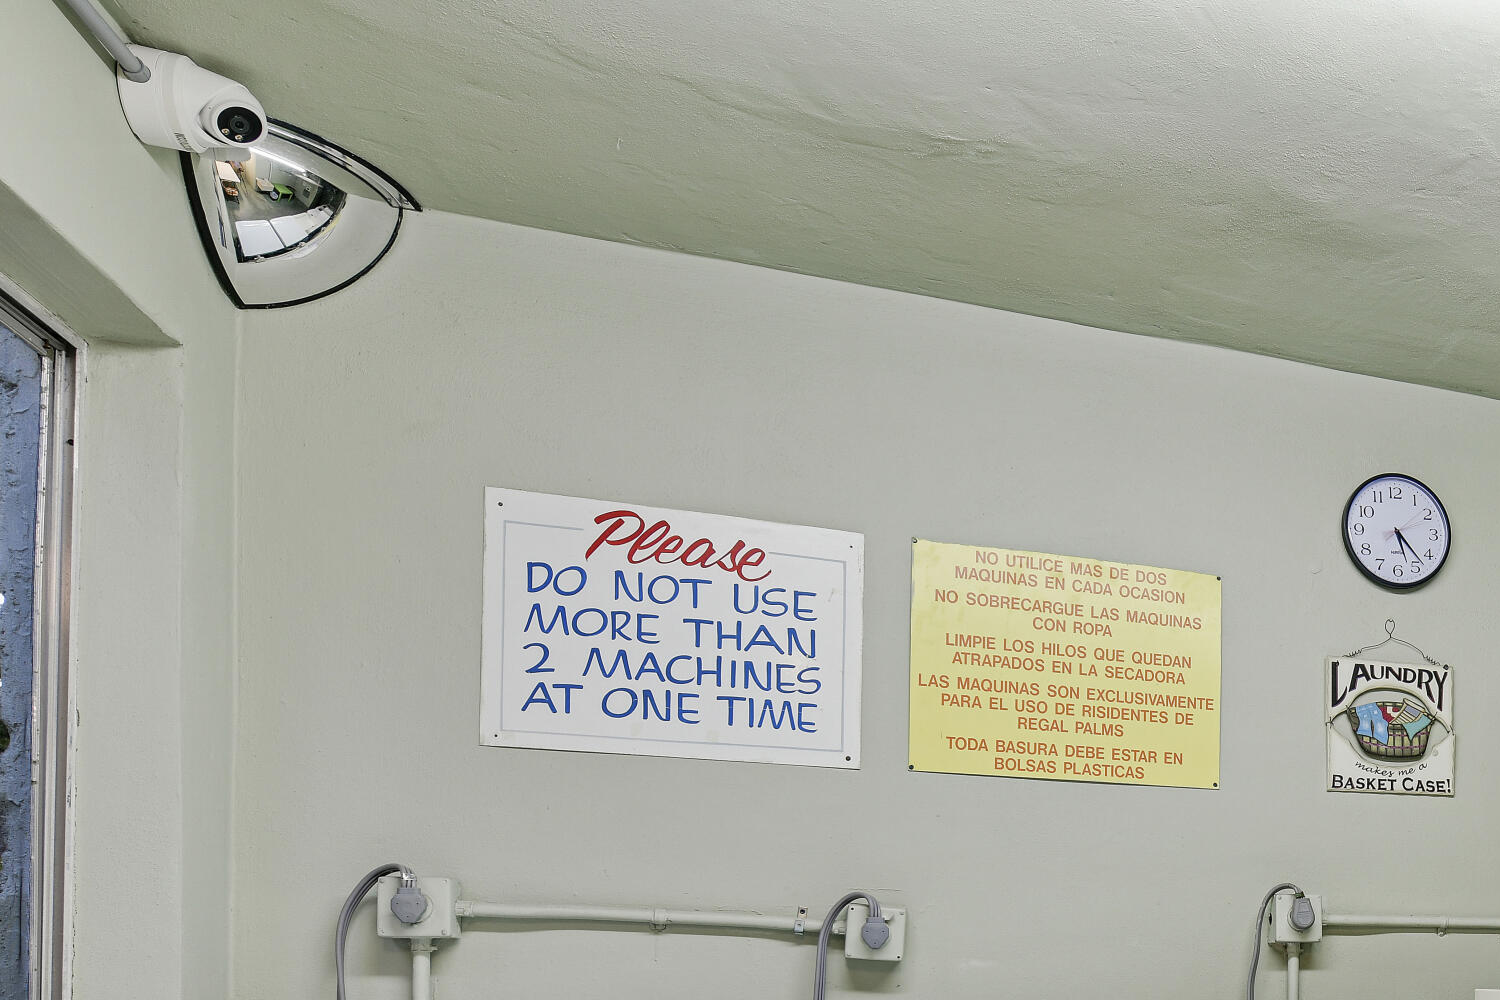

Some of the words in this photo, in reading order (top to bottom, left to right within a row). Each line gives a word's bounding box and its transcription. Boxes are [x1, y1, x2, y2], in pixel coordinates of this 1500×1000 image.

[1373, 491, 1382, 503] 11
[1389, 487, 1402, 499] 12
[1413, 495, 1416, 506] 1
[1360, 506, 1374, 518] 10
[1424, 509, 1432, 520] 2
[1354, 523, 1364, 535] 9
[1429, 529, 1438, 541] 3
[586, 510, 771, 581] Please
[1361, 543, 1371, 555] 8
[1424, 549, 1433, 560] 4
[976, 551, 998, 565] NO
[1006, 556, 1063, 573] UTILICE
[1070, 562, 1102, 578] MAS
[1110, 568, 1129, 580] DE
[1136, 570, 1167, 585] DOS
[1376, 559, 1384, 570] 7
[1393, 565, 1403, 577] 6
[1411, 561, 1420, 573] 5
[527, 562, 587, 596] DO
[614, 570, 712, 608] NOT
[734, 583, 817, 621] USE
[955, 566, 1038, 587] MAQUINAS
[1045, 576, 1064, 590] EN
[1072, 579, 1112, 596] CADA
[1119, 586, 1185, 604] OCASION
[935, 589, 958, 603] NO
[966, 592, 1084, 616] SOBRECARGUE
[1091, 606, 1119, 620] LAS
[1126, 611, 1202, 630] MAQUINAS
[524, 603, 659, 644] MORE
[683, 618, 815, 658] THAN
[1033, 617, 1066, 632] CON
[1073, 621, 1112, 637] ROPA
[946, 633, 996, 649] LIMPIE
[1003, 638, 1034, 654] LOS
[1041, 643, 1086, 658] HILOS
[1094, 648, 1125, 662] QUE
[1132, 652, 1191, 668] QUEDAN
[522, 643, 554, 673] 2
[583, 647, 821, 694] MACHINES
[952, 652, 1044, 671] ATRAPADOS
[1052, 660, 1072, 674] EN
[1079, 663, 1097, 676] LA
[1105, 666, 1185, 684] SECADORA
[918, 674, 949, 688] LAS
[957, 677, 1040, 696] MAQUINAS
[1047, 685, 1079, 699] SON
[1087, 688, 1214, 711] EXCLUSIVAMENTE
[1332, 662, 1448, 712] LAUNDRY
[521, 682, 583, 714] AT
[601, 688, 700, 724] ONE
[717, 696, 817, 732] TIME
[941, 694, 981, 708] PARA
[989, 698, 1008, 711] EL
[1015, 700, 1048, 714] USO
[1055, 703, 1075, 716] DE
[1082, 705, 1168, 723] RISIDENTES
[1175, 713, 1194, 725] DE
[1017, 717, 1068, 732] REGAL
[1075, 721, 1124, 737] PALMS
[946, 737, 988, 752] TODA
[996, 740, 1058, 756] BASURA
[1065, 745, 1104, 760] DEBE
[1111, 748, 1157, 763] ESTAR
[1164, 752, 1183, 765] EN
[994, 758, 1056, 773] BOLSAS
[1063, 762, 1145, 779] PLASTICAS
[1355, 760, 1394, 777] makes
[1399, 767, 1415, 776] me
[1419, 762, 1427, 771] a
[1332, 775, 1396, 790] BASKET
[1402, 778, 1451, 793] CASE!
